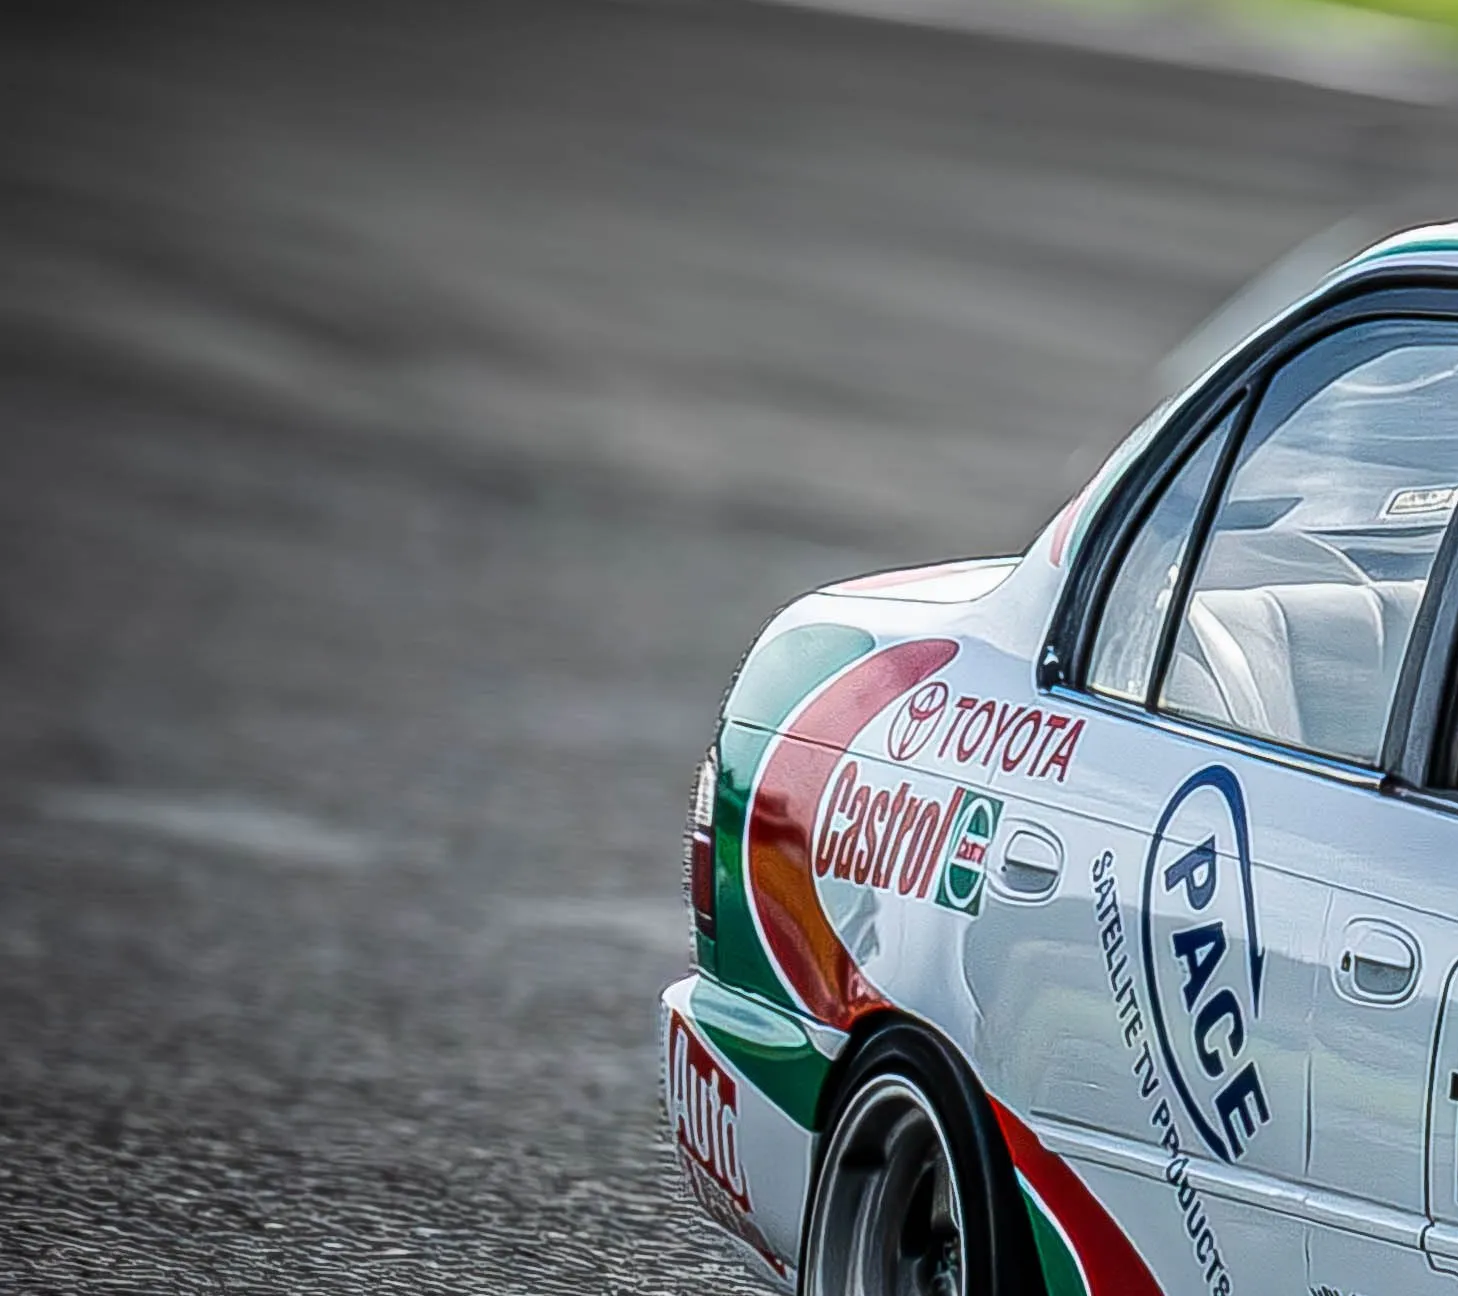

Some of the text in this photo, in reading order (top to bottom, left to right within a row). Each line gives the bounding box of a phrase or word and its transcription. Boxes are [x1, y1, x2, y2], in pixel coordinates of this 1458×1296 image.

[938, 697, 1086, 781] TOYOTA
[815, 761, 966, 898] Castrol
[1092, 850, 1144, 1048] SATELLITE
[1133, 1040, 1160, 1098] TV
[1164, 835, 1270, 1159] PACE
[675, 1026, 743, 1197] Auto
